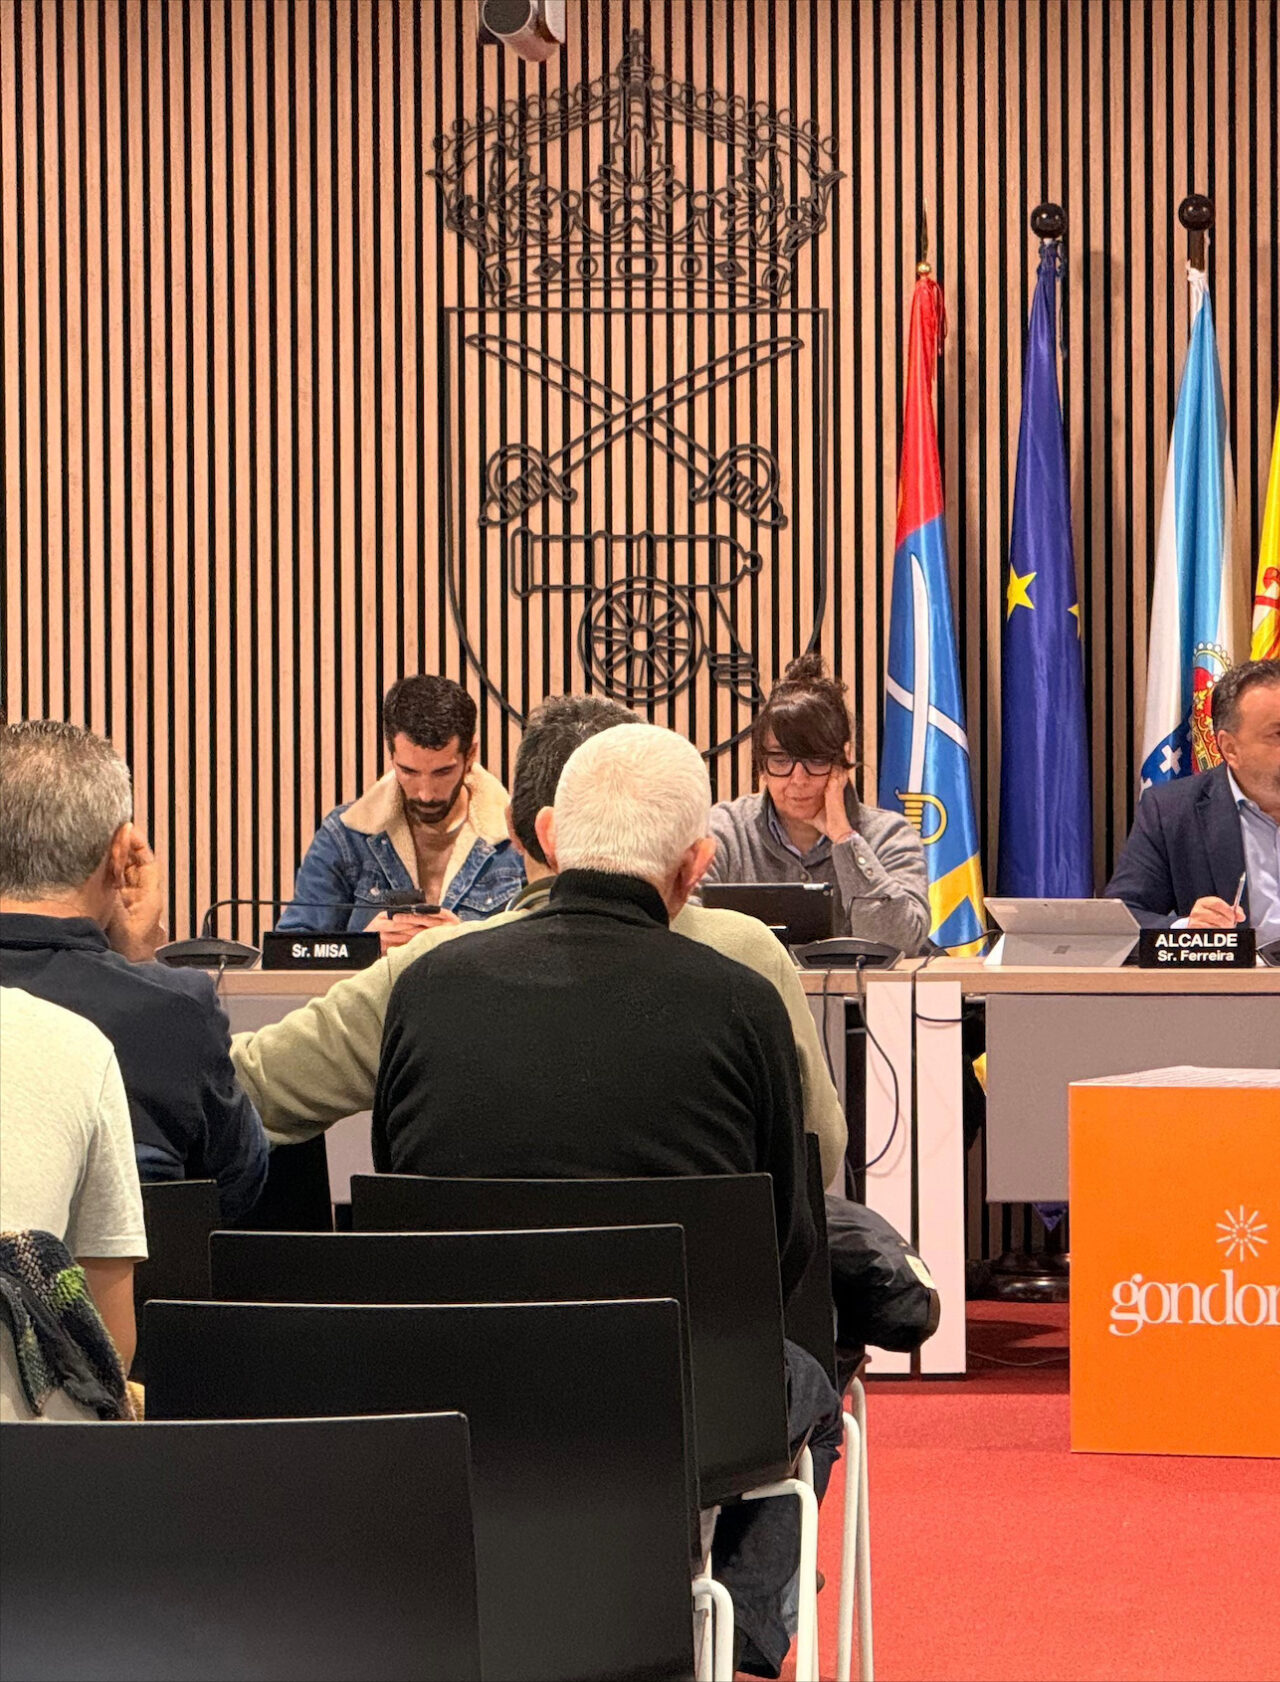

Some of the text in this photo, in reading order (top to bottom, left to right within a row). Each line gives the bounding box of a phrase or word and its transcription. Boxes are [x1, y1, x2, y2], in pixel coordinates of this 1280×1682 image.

[1155, 933, 1239, 948] ALCALDE
[291, 943, 349, 958] Sr. MISA
[1157, 950, 1235, 962] Sr. Ferreira
